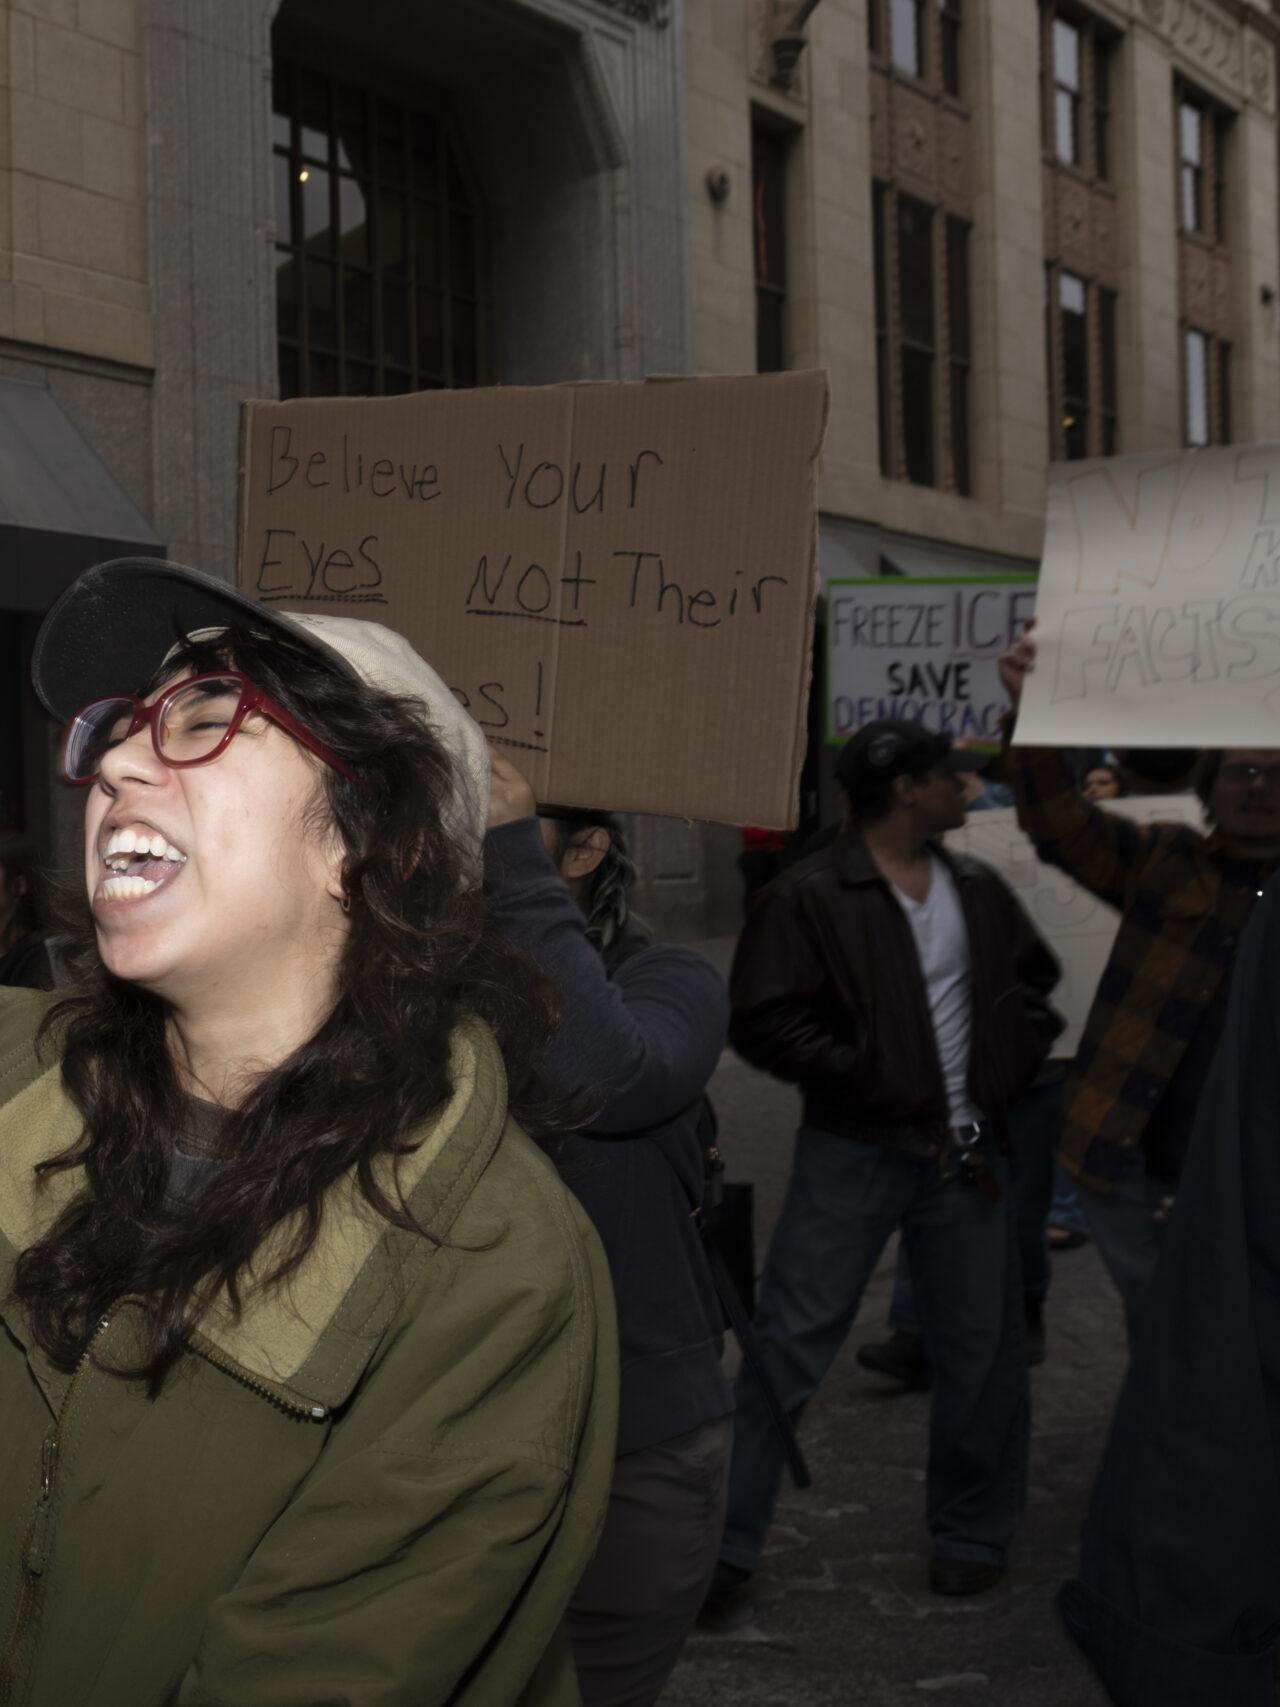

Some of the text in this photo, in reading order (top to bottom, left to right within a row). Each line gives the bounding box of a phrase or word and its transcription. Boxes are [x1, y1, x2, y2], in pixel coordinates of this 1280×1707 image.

[266, 426, 663, 513] Believe Your
[257, 529, 383, 595] Eyes
[613, 552, 787, 627] Their
[833, 597, 946, 650] FREEZE
[886, 660, 972, 701] SAVE
[833, 696, 1009, 738] DEMOCRAC
